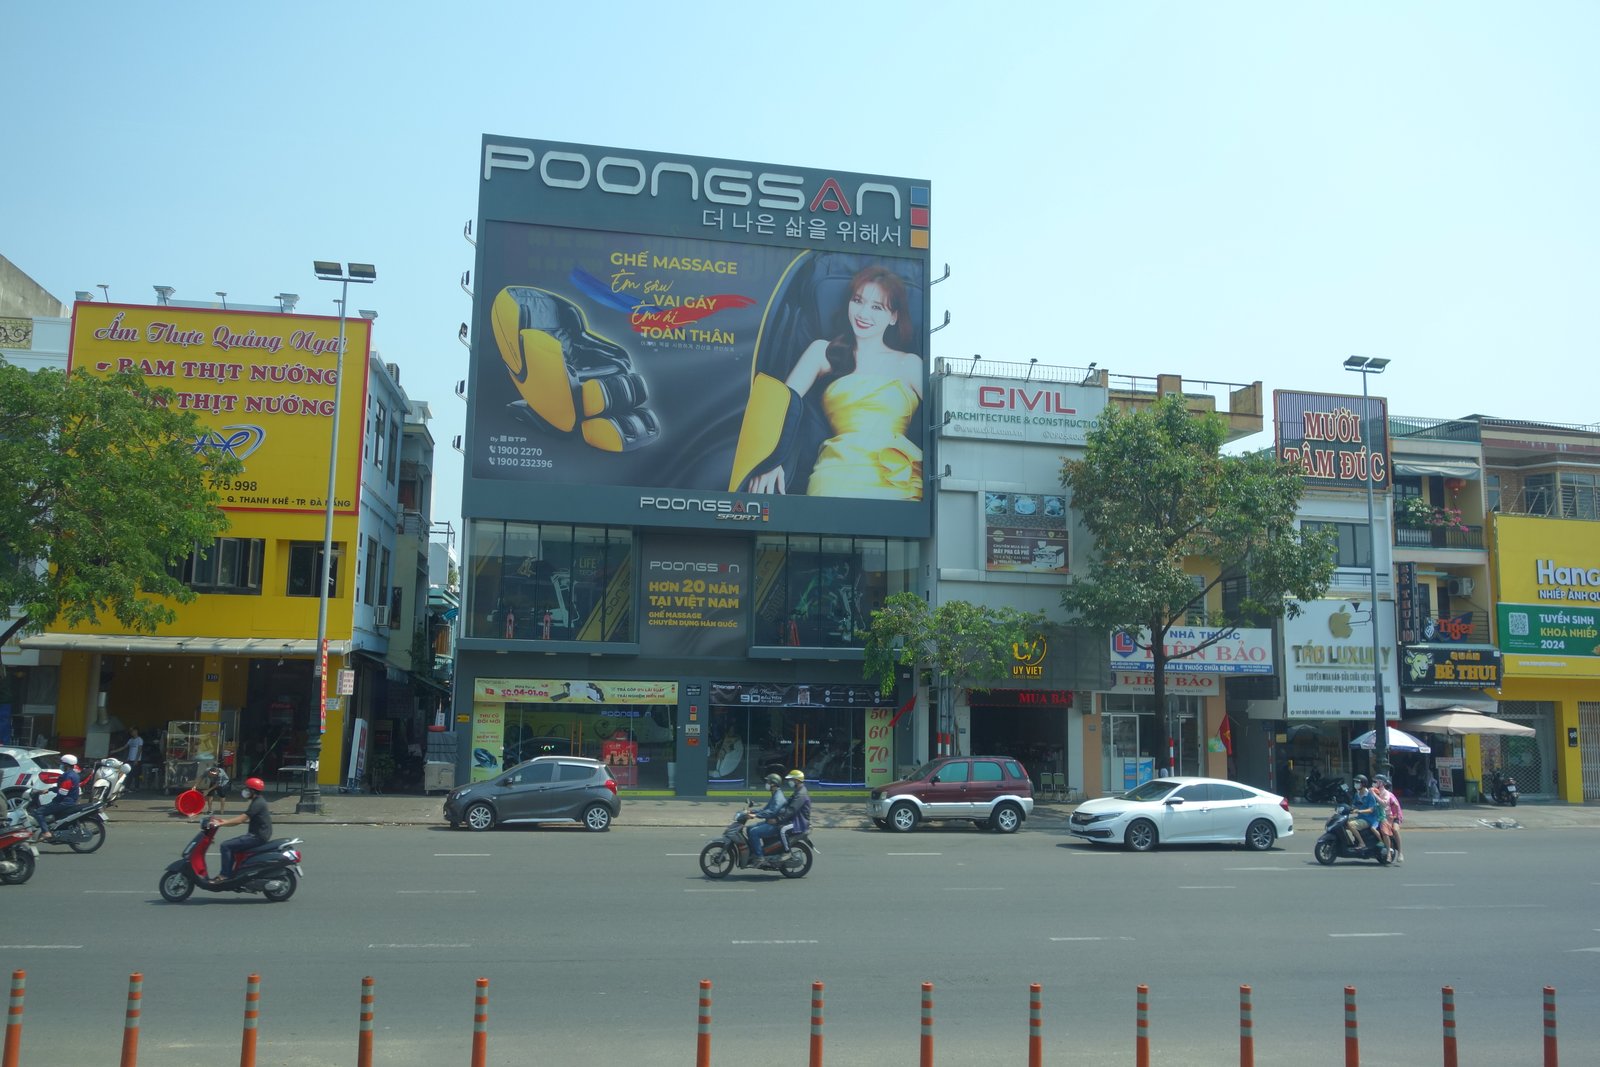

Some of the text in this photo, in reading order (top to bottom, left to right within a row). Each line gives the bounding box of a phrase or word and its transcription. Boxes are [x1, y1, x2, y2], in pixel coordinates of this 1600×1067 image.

[702, 208, 902, 247] 더 나은 삶을 위해서
[610, 250, 738, 275] GHẾ MASSAGE
[644, 279, 674, 294] sâu
[654, 294, 717, 310] VAI GÁY
[148, 322, 205, 347] Thực
[213, 325, 283, 353] Quảng
[641, 326, 735, 345] TOÀN THÂN
[181, 362, 244, 384] THỊT
[250, 363, 338, 386] NƯỚNG
[177, 392, 239, 414] THỊT
[245, 394, 336, 418] NƯỚNG
[979, 386, 1076, 415] CIVIL
[950, 411, 1098, 428] ARCHITECTURE & CONSTRUCTIO
[1304, 407, 1361, 443] MƯỜI
[497, 446, 543, 456] 1900 2270
[497, 457, 553, 468] 1900 232396
[1339, 445, 1385, 482] ĐỨC
[240, 496, 270, 504] THANH
[272, 496, 289, 505] KHÊ
[310, 497, 322, 506] ĐÀ
[716, 513, 760, 521] SPORT
[649, 579, 740, 594] HƠN 20 NĂM
[1539, 586, 1566, 600] NHIẾP
[649, 594, 740, 610] TẠI VIỆT NAM
[648, 609, 665, 618] GHẾ
[1539, 611, 1594, 625] TUYỂN SINH
[649, 618, 678, 626] CHUYÊN
[717, 619, 738, 628] QUỐC
[1439, 618, 1477, 640] Tiger
[1169, 629, 1241, 640] NHÀ THUỐC
[1540, 625, 1597, 638] KHOÁ NHIẾP
[1216, 640, 1267, 662] BẢO
[1541, 640, 1565, 649] 2024
[1450, 650, 1480, 661] QUÁN
[1013, 666, 1043, 675] UY VIET
[1184, 663, 1203, 671] THUỐC
[1434, 660, 1497, 681] BÊ THUI
[1176, 674, 1213, 687] BẢO
[870, 708, 888, 720] 50
[868, 725, 889, 739] 60
[868, 745, 889, 763] 70
